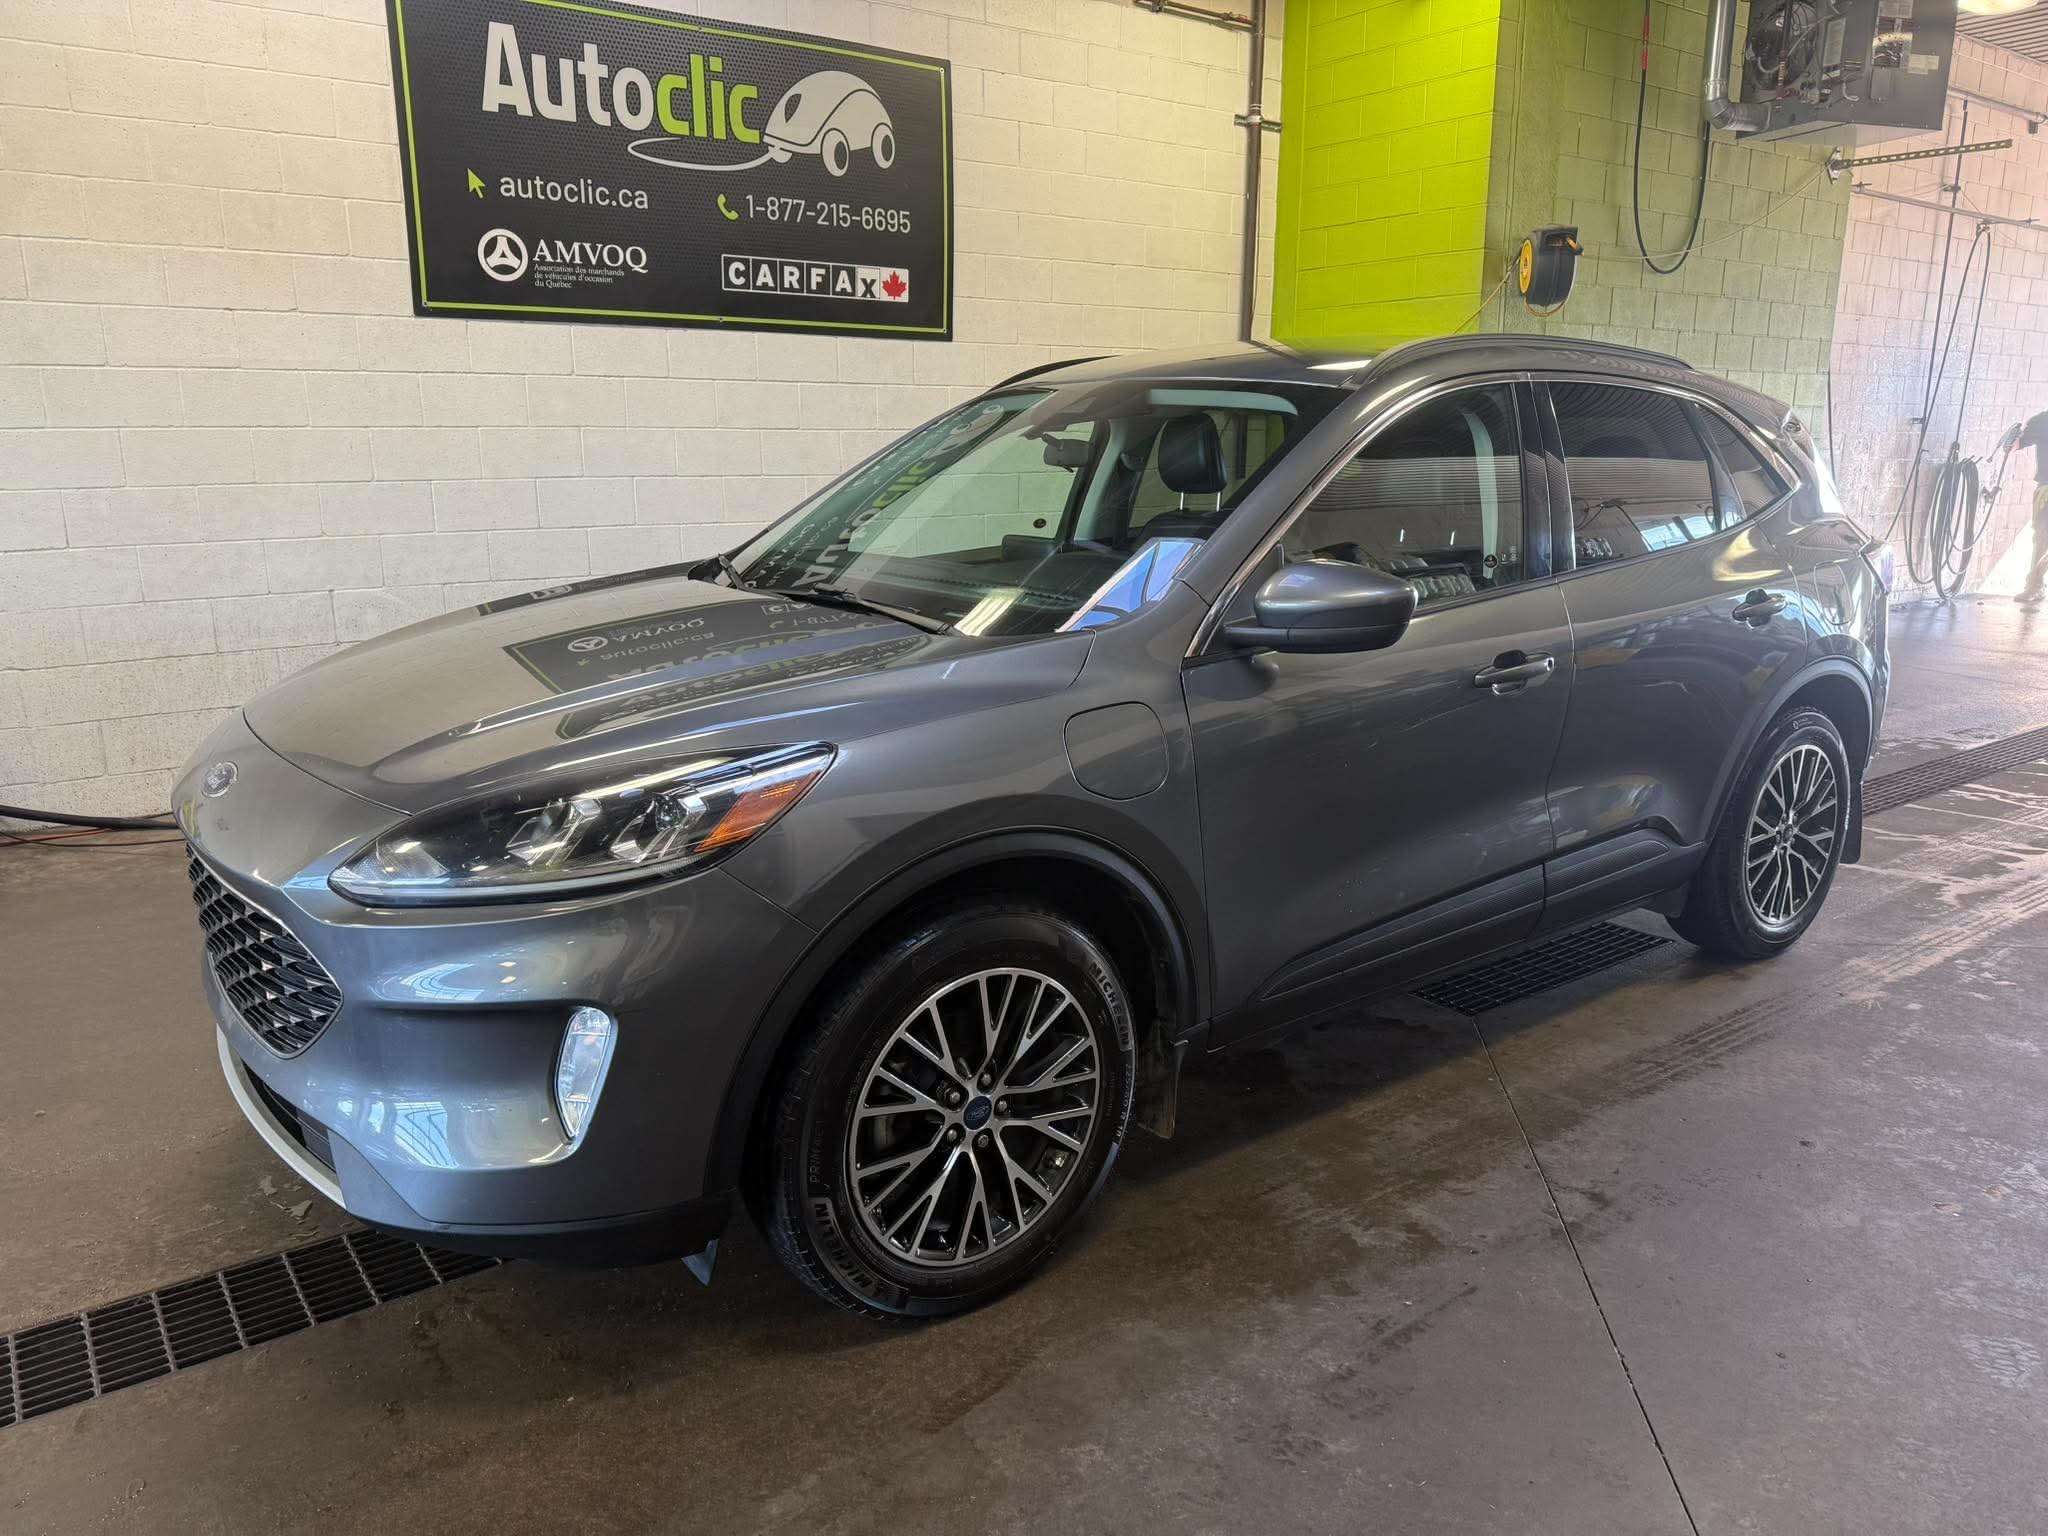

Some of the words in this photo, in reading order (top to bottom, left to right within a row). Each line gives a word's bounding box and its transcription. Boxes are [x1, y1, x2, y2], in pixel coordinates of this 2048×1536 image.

[482, 21, 760, 144] Autoclic
[500, 176, 648, 209] autoclic.ca
[745, 194, 911, 233] 1-877-215-6695
[533, 239, 649, 273] AMVOQ
[534, 264, 574, 273] Association
[534, 279, 544, 287] du
[728, 260, 877, 299] CARFAX
